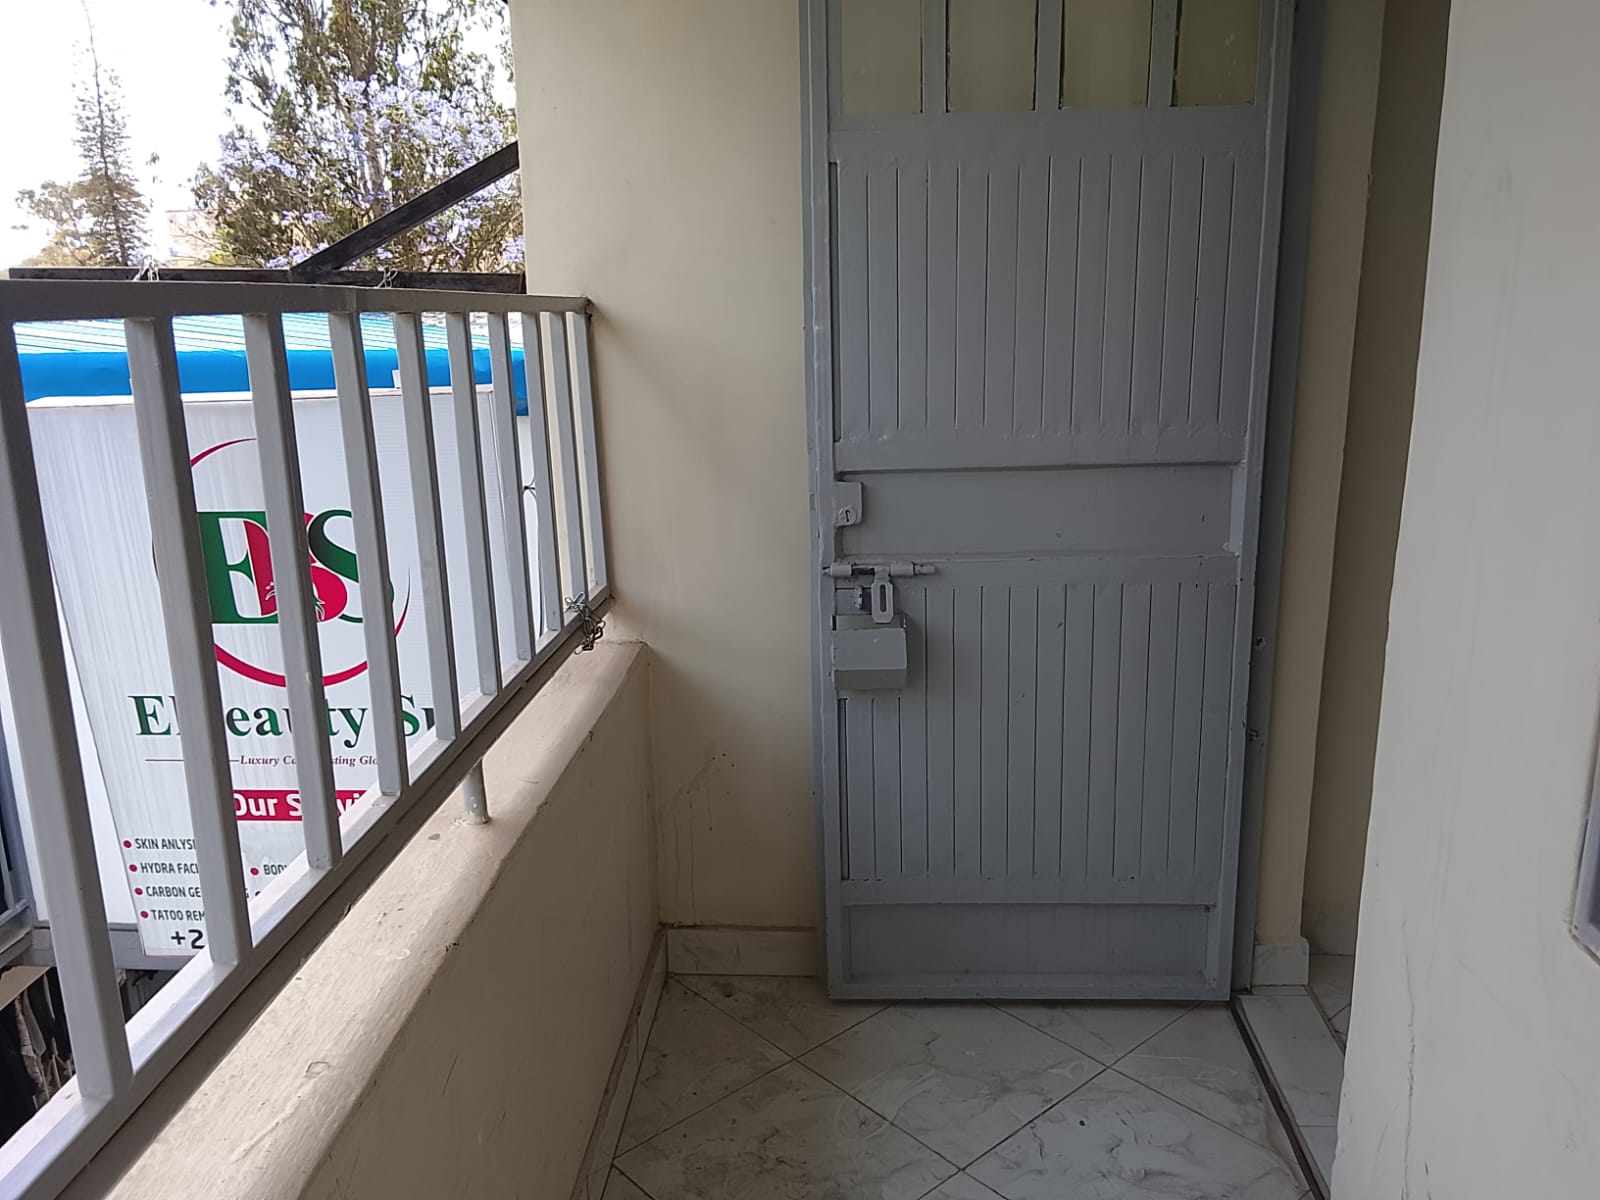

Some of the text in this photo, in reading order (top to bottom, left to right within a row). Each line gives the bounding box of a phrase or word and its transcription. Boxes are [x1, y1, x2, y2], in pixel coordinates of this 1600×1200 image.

[240, 755, 279, 768] Luxury
[359, 755, 378, 765] Glo
[233, 792, 278, 817] Our
[135, 837, 196, 850] SKIN ANLYSI
[140, 862, 199, 874] HYDRA FACI
[263, 864, 287, 875] BOD
[146, 886, 201, 898] CARBON GE
[150, 909, 205, 921] TATOO REM
[171, 929, 205, 949] +2
